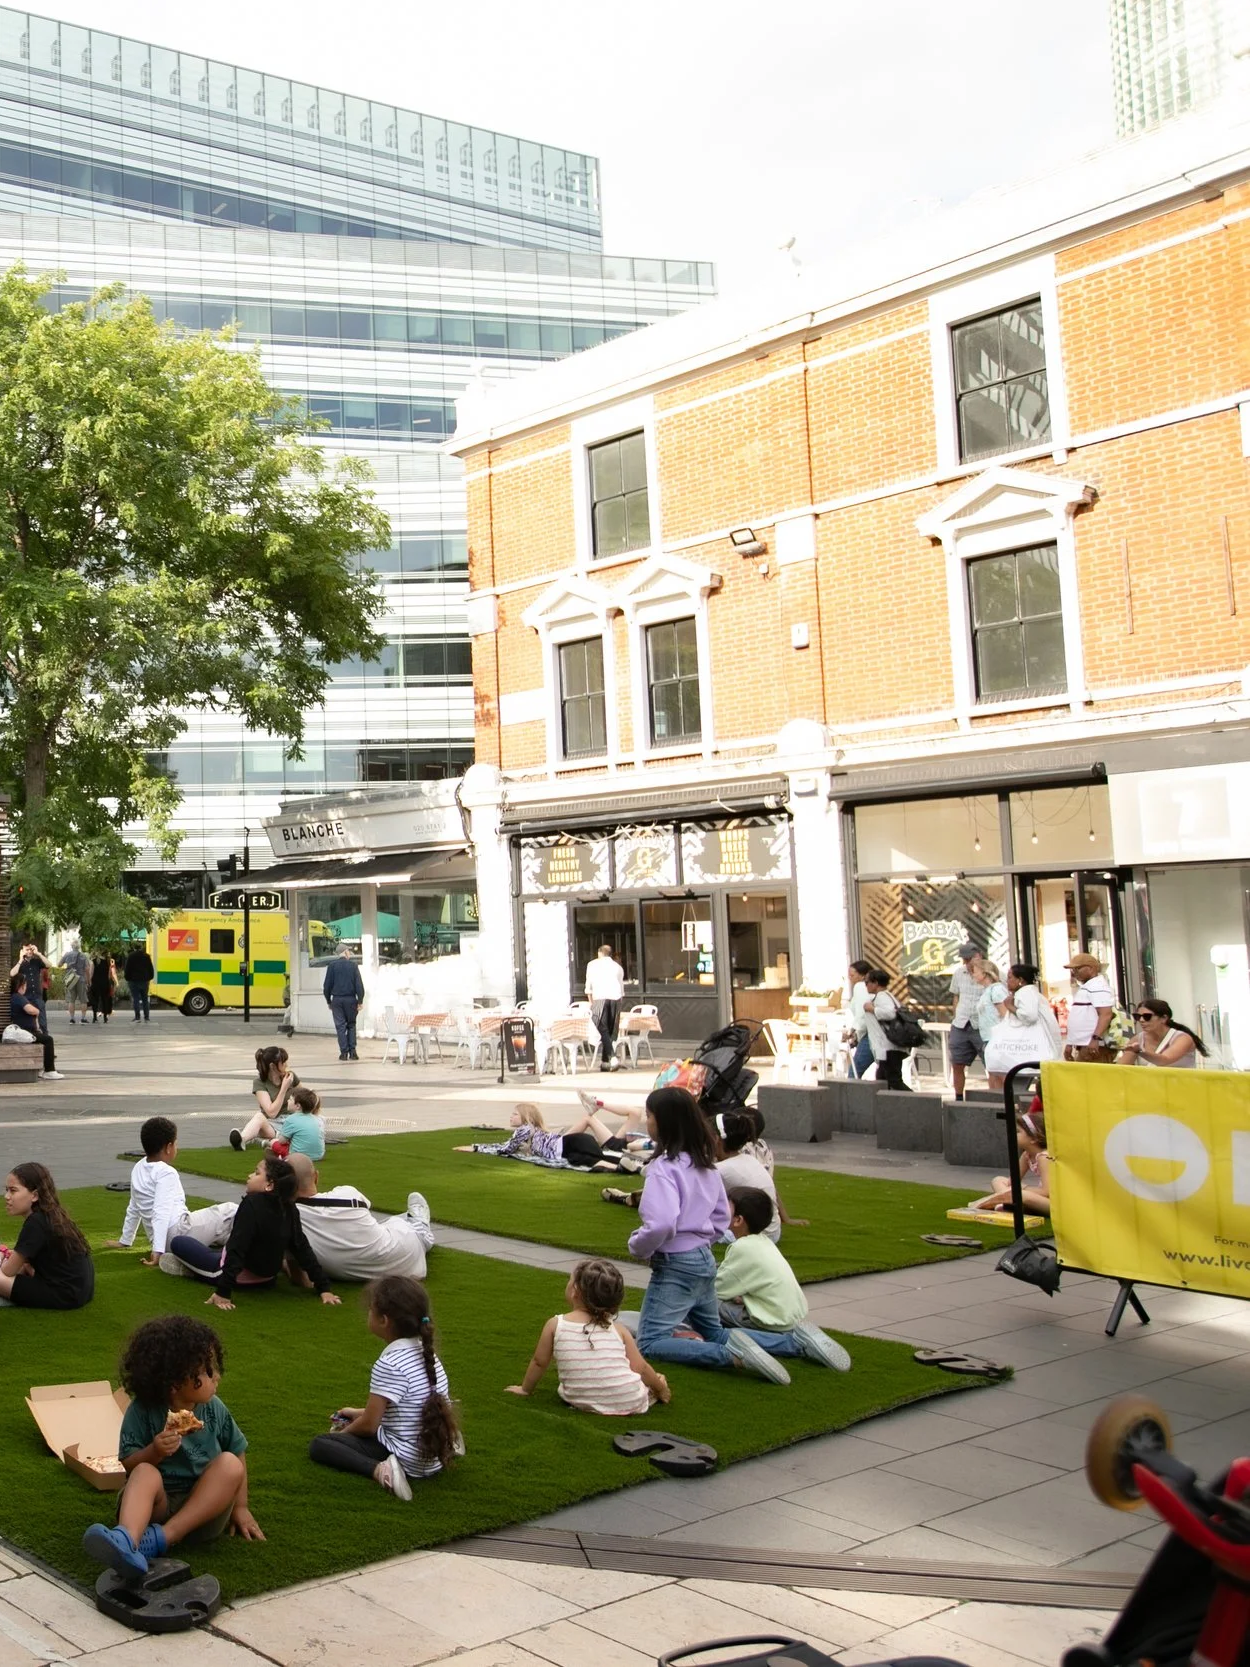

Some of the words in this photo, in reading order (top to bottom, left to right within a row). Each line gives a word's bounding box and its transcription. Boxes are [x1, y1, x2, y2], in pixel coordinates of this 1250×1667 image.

[282, 822, 345, 842] BLANCHE
[285, 836, 348, 850] EATERY
[903, 920, 964, 945] BABA
[921, 938, 946, 965] G
[1213, 1234, 1235, 1246] For
